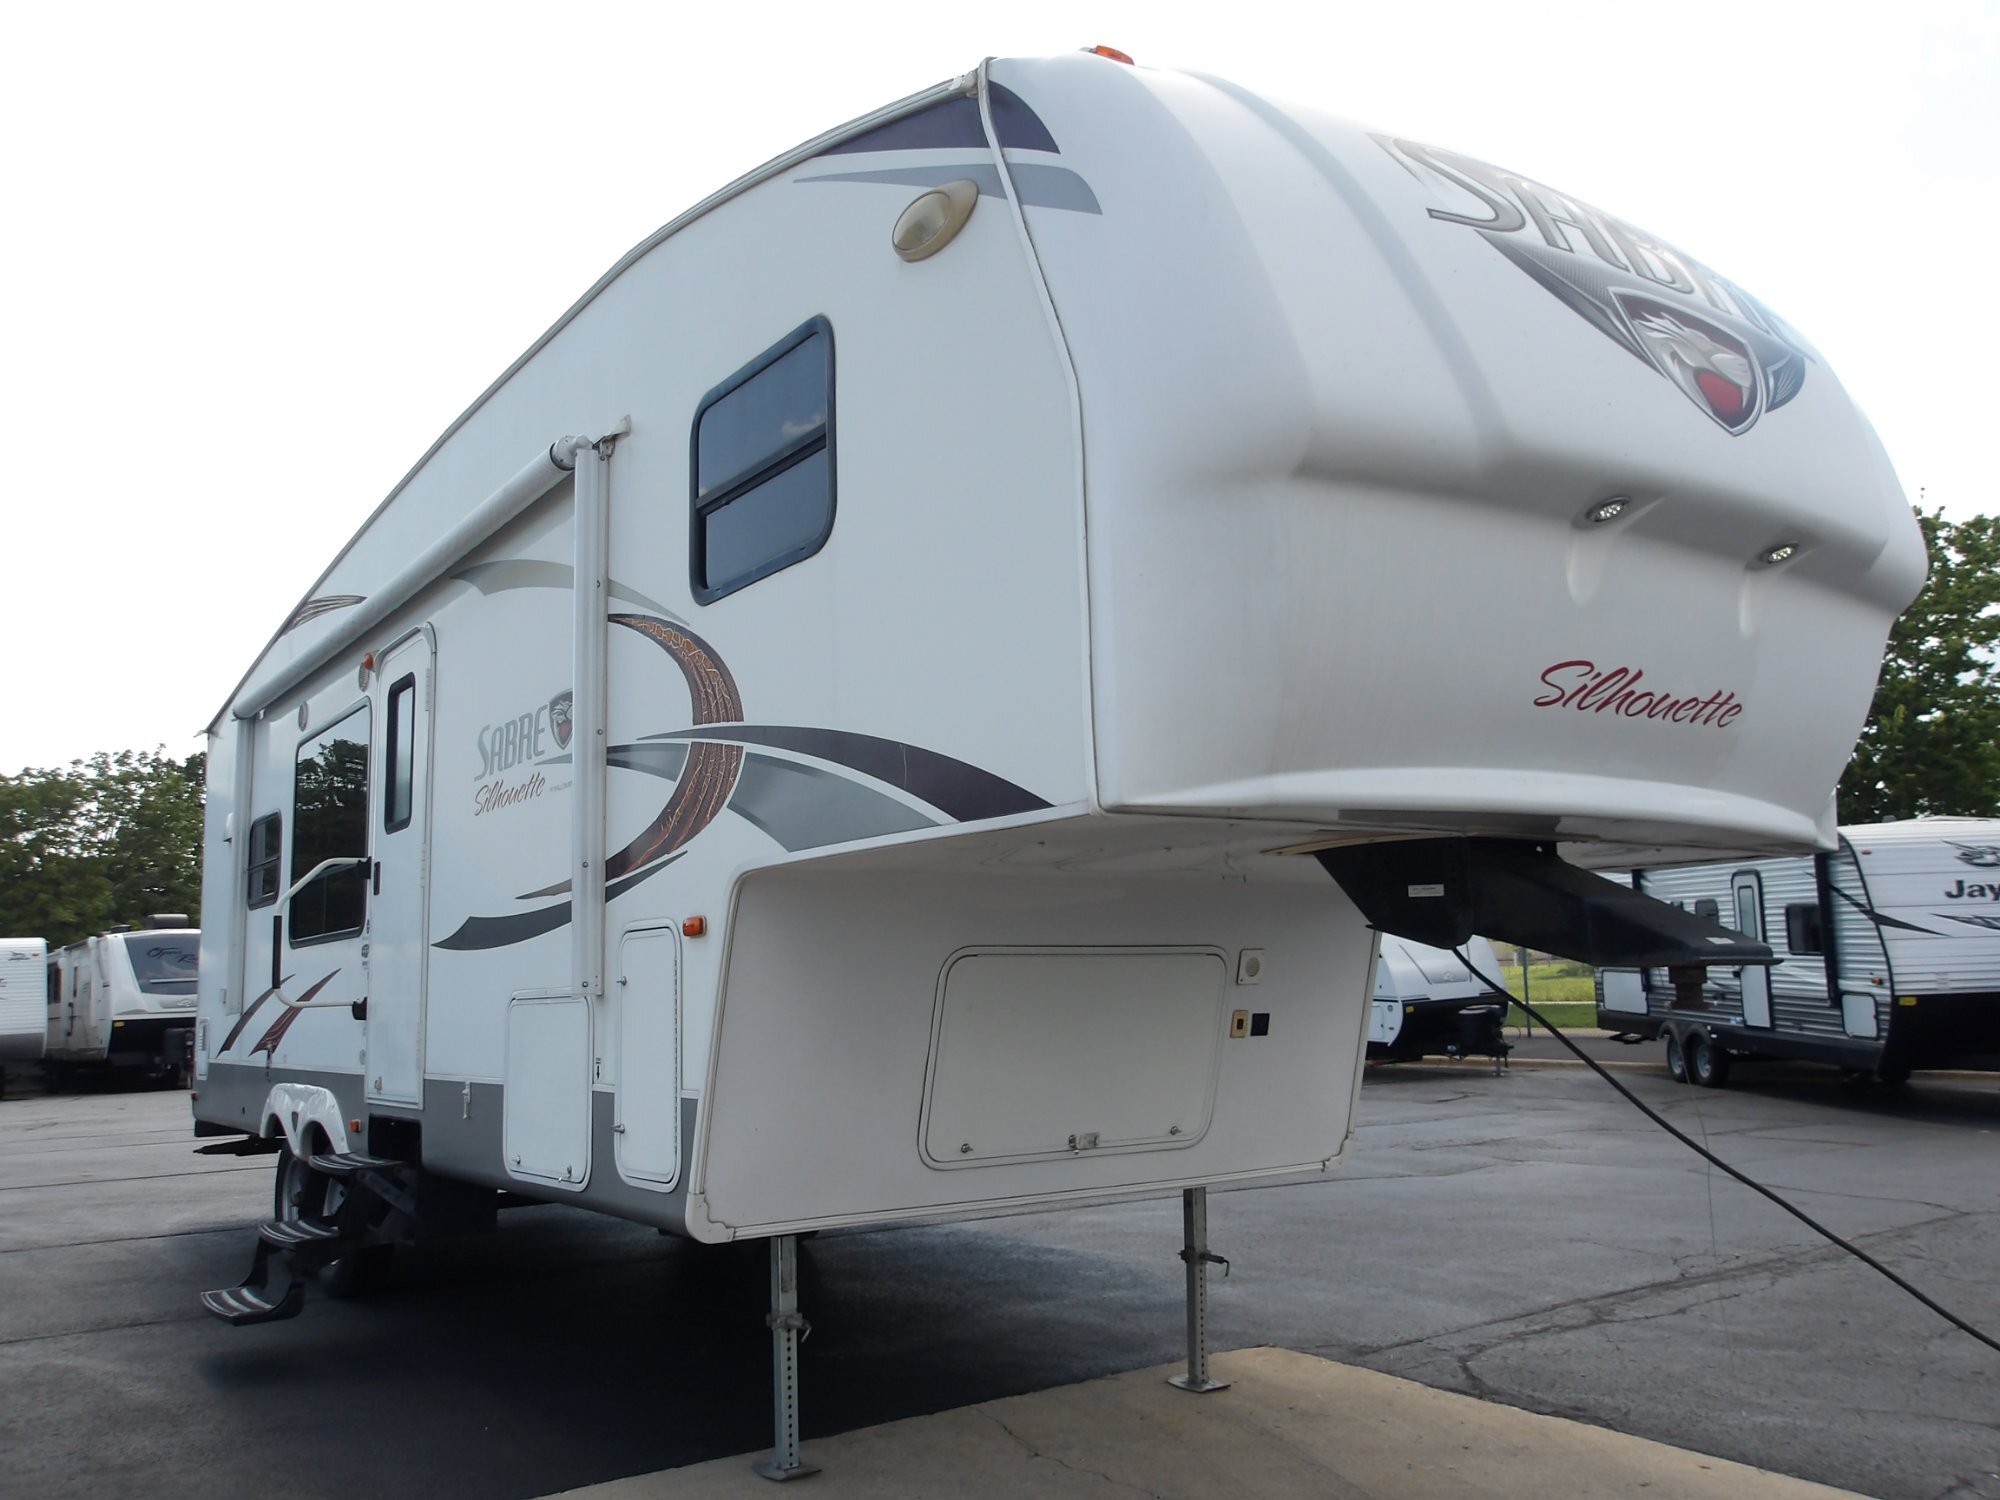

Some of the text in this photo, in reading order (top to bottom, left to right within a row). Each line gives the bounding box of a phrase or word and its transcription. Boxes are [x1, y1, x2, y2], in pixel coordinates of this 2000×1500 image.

[1533, 660, 1742, 728] Silhouette
[474, 704, 548, 782] SABRE
[474, 771, 546, 816] Silhouette
